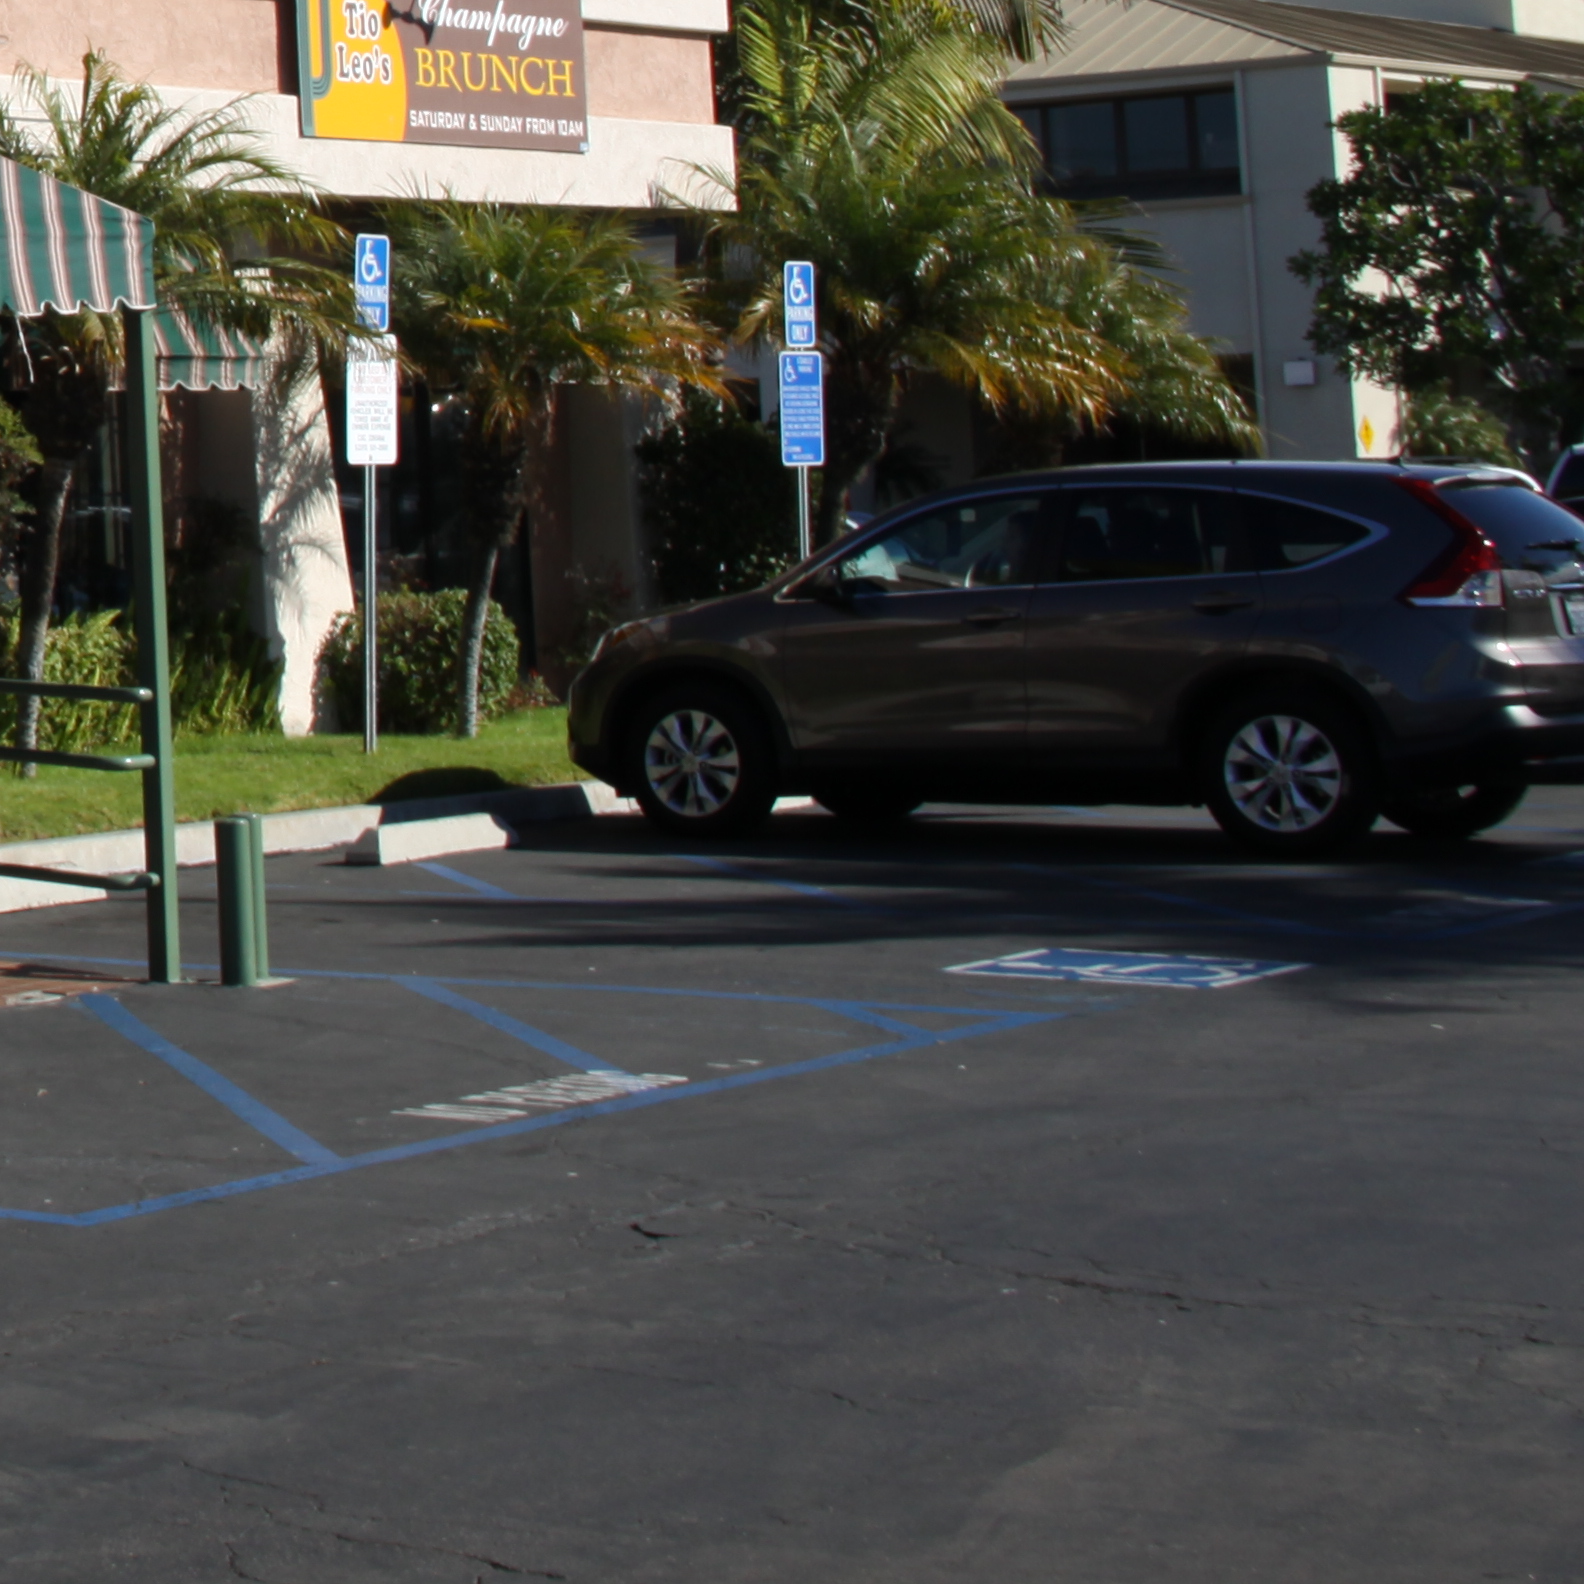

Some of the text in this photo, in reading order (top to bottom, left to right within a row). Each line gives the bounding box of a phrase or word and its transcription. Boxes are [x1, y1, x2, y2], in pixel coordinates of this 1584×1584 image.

[343, 0, 380, 40] Tio
[335, 42, 392, 85] Leo's
[414, 48, 576, 97] BRUNCH
[409, 110, 583, 137] SATURDAY & SUNDAY FROM 10AM
